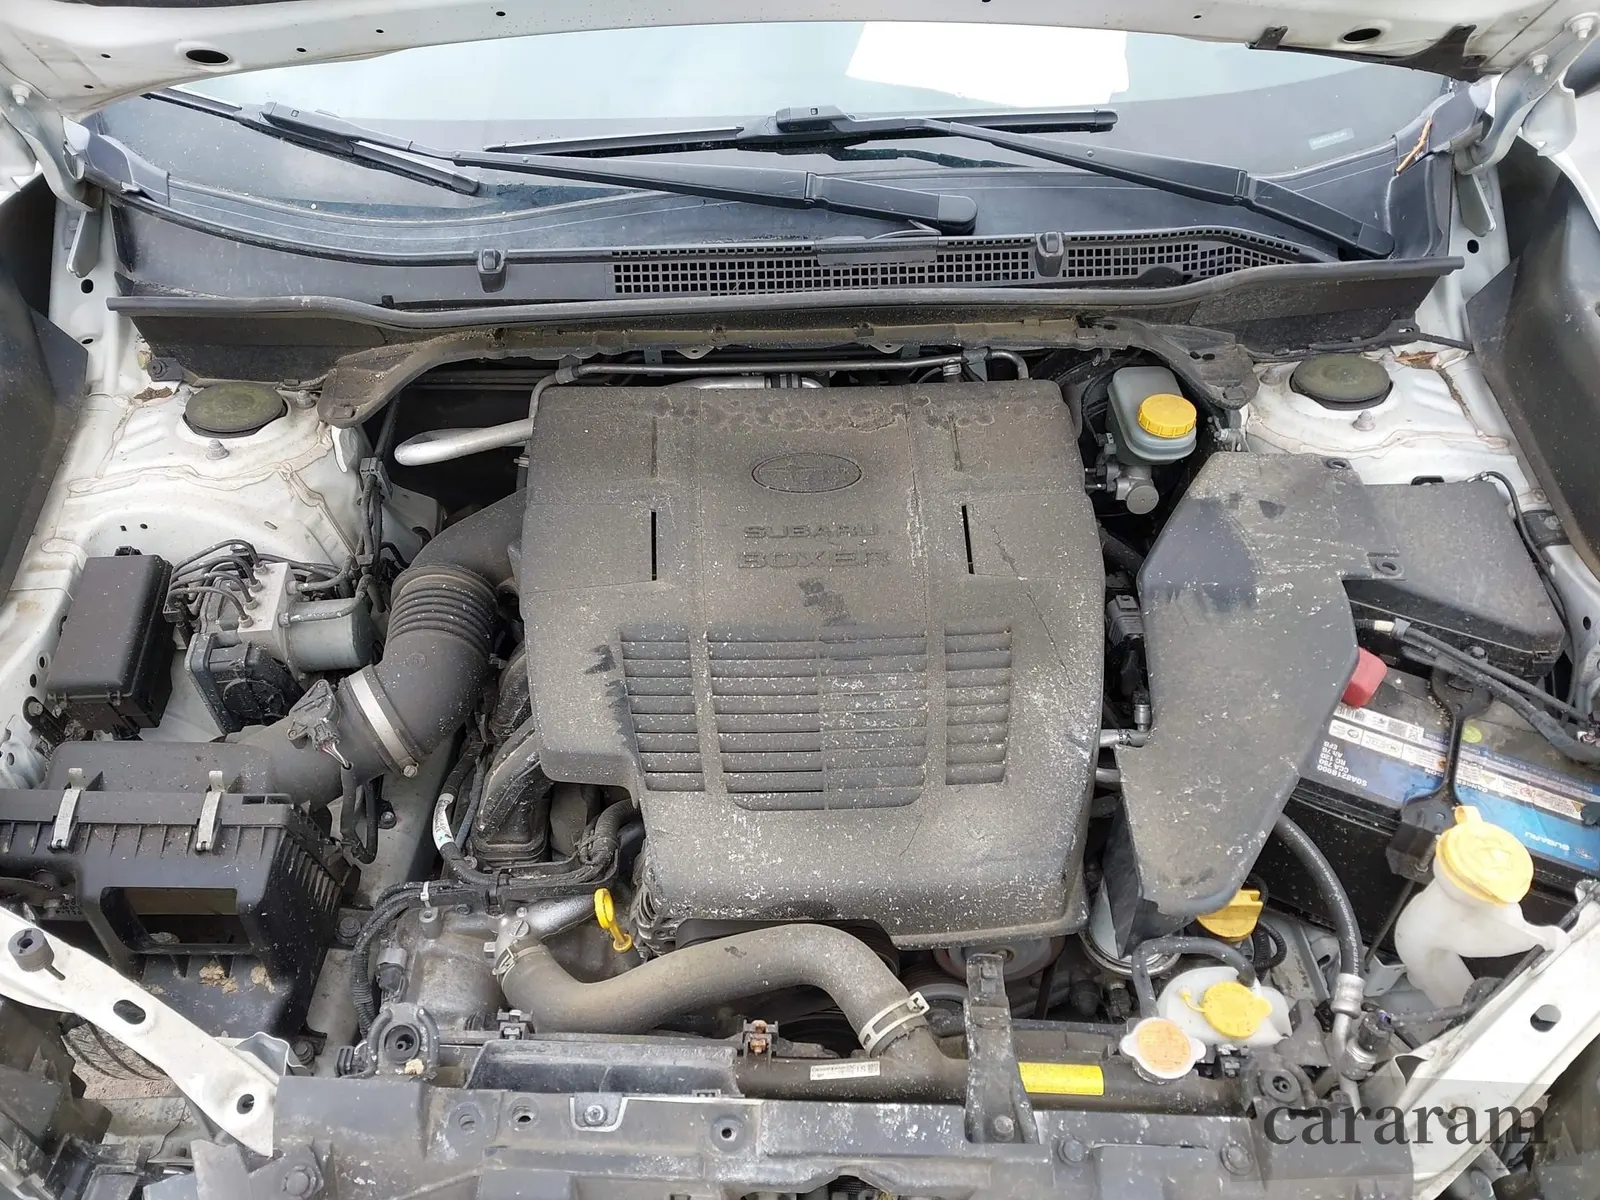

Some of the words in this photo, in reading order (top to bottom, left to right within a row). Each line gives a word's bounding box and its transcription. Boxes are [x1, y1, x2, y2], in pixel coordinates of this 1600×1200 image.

[743, 524, 879, 539] SUBARU
[738, 550, 891, 569] BOXER
[1524, 831, 1571, 851] SUBARU
